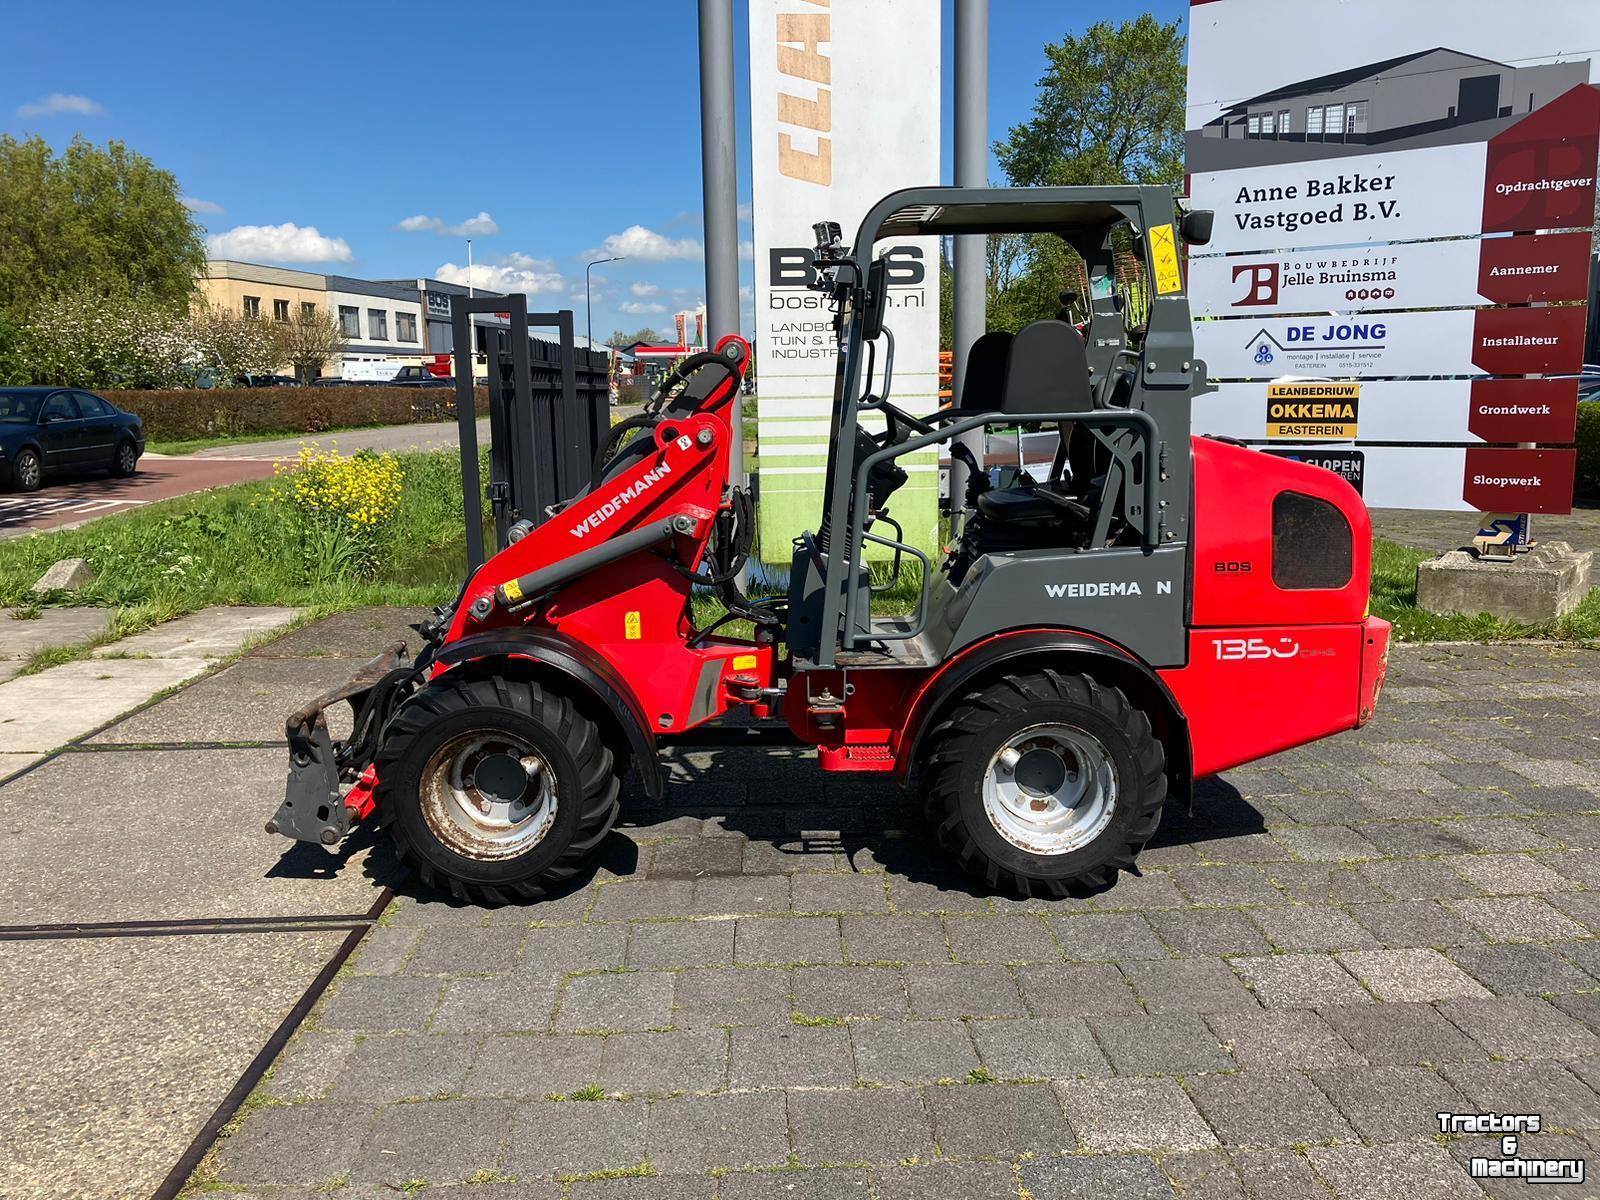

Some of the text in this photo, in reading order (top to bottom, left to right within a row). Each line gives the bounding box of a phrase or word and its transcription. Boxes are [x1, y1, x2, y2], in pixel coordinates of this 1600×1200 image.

[776, 0, 832, 186] CLA
[1235, 174, 1395, 204] Anne Bakker
[1495, 178, 1593, 195] Opdrachtgever
[1235, 200, 1401, 232] Vastgoed B.V.
[769, 245, 926, 287] BS
[1284, 257, 1398, 271] BOUWBEDRIJF
[1489, 265, 1560, 277] Aannemer
[1282, 269, 1397, 288] Jelle Bruinsma
[771, 322, 834, 333] LANDBO
[1287, 324, 1386, 342] DE JONG
[771, 336, 806, 346] TUIN
[811, 335, 824, 346] &
[1482, 335, 1558, 347] Installateur
[1286, 351, 1382, 361] montage installatie service
[1271, 386, 1355, 397] LEANBEDRIUW
[1269, 403, 1355, 419] OKKEMA
[1479, 404, 1551, 415] Grondwerk
[1278, 425, 1344, 436] EASTEREIN
[1473, 475, 1542, 488] Sloopwerk
[1215, 562, 1252, 572] BOS
